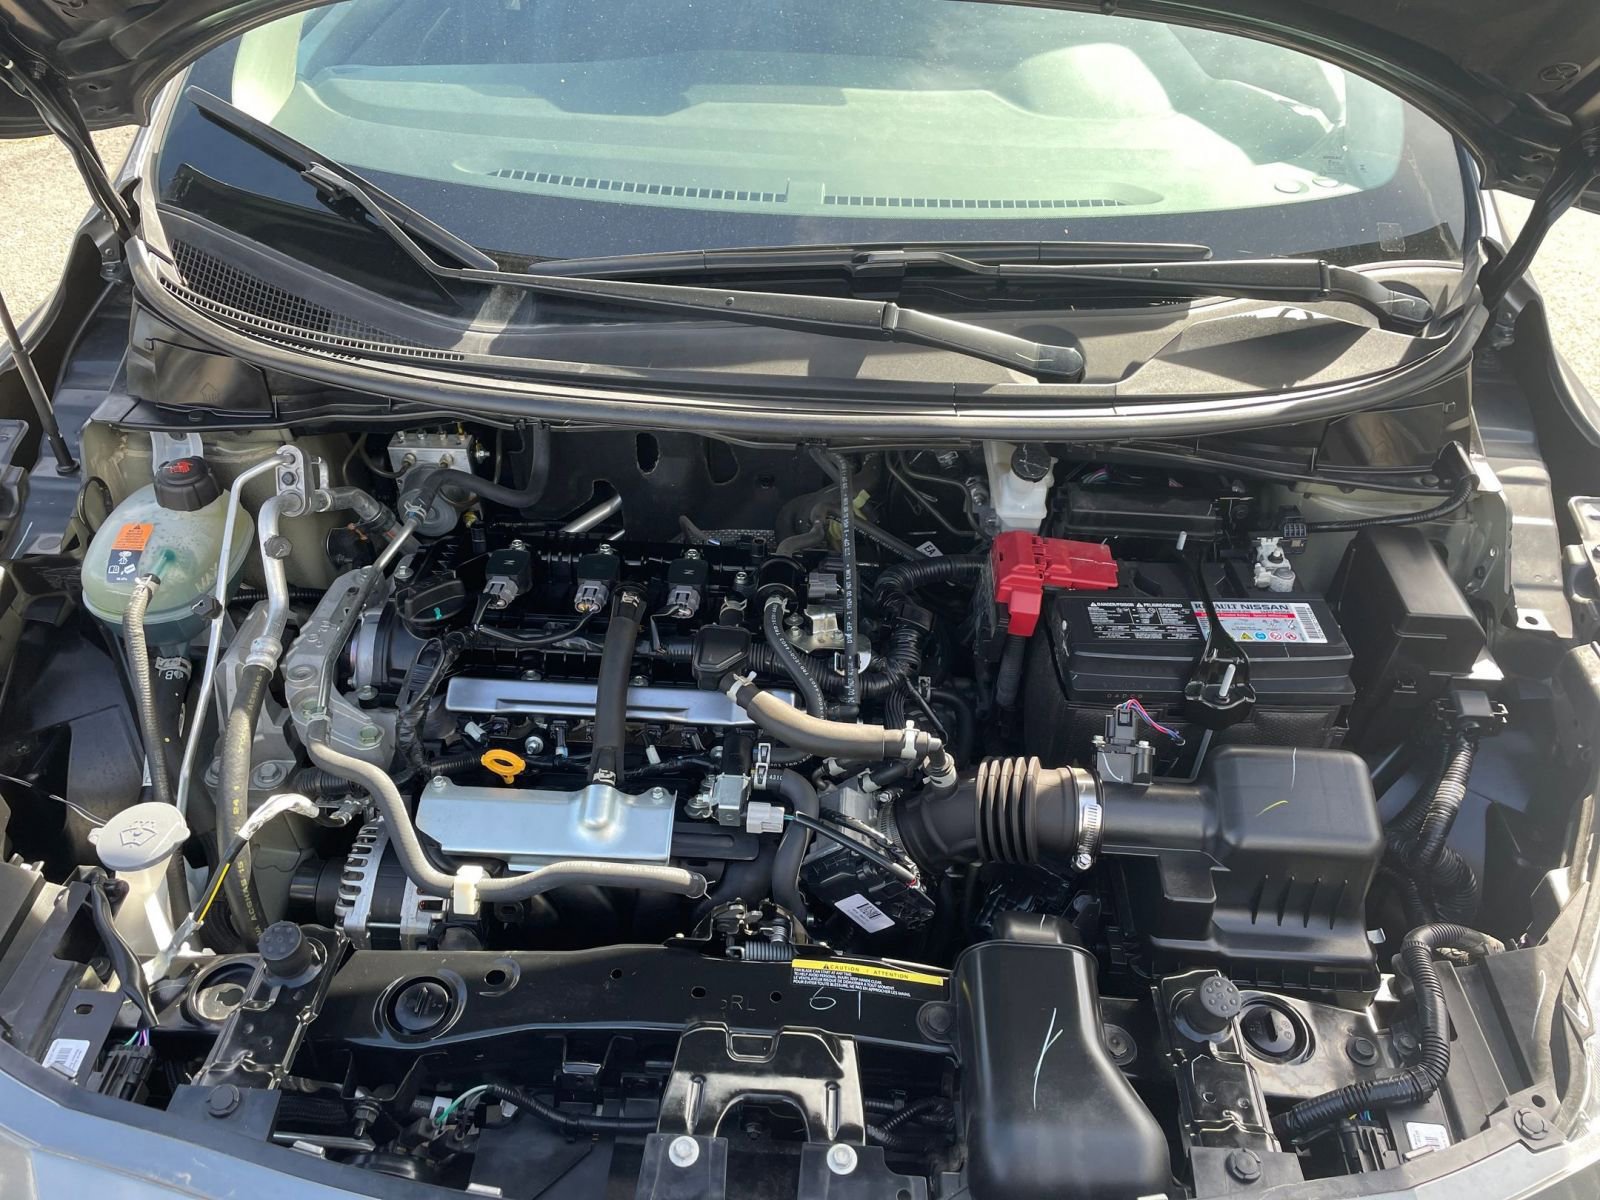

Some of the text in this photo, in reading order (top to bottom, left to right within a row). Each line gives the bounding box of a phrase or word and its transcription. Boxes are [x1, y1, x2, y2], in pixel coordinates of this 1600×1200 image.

[924, 544, 936, 555] EA
[830, 964, 860, 972] CAUTION
[873, 970, 909, 979] ATTENTION
